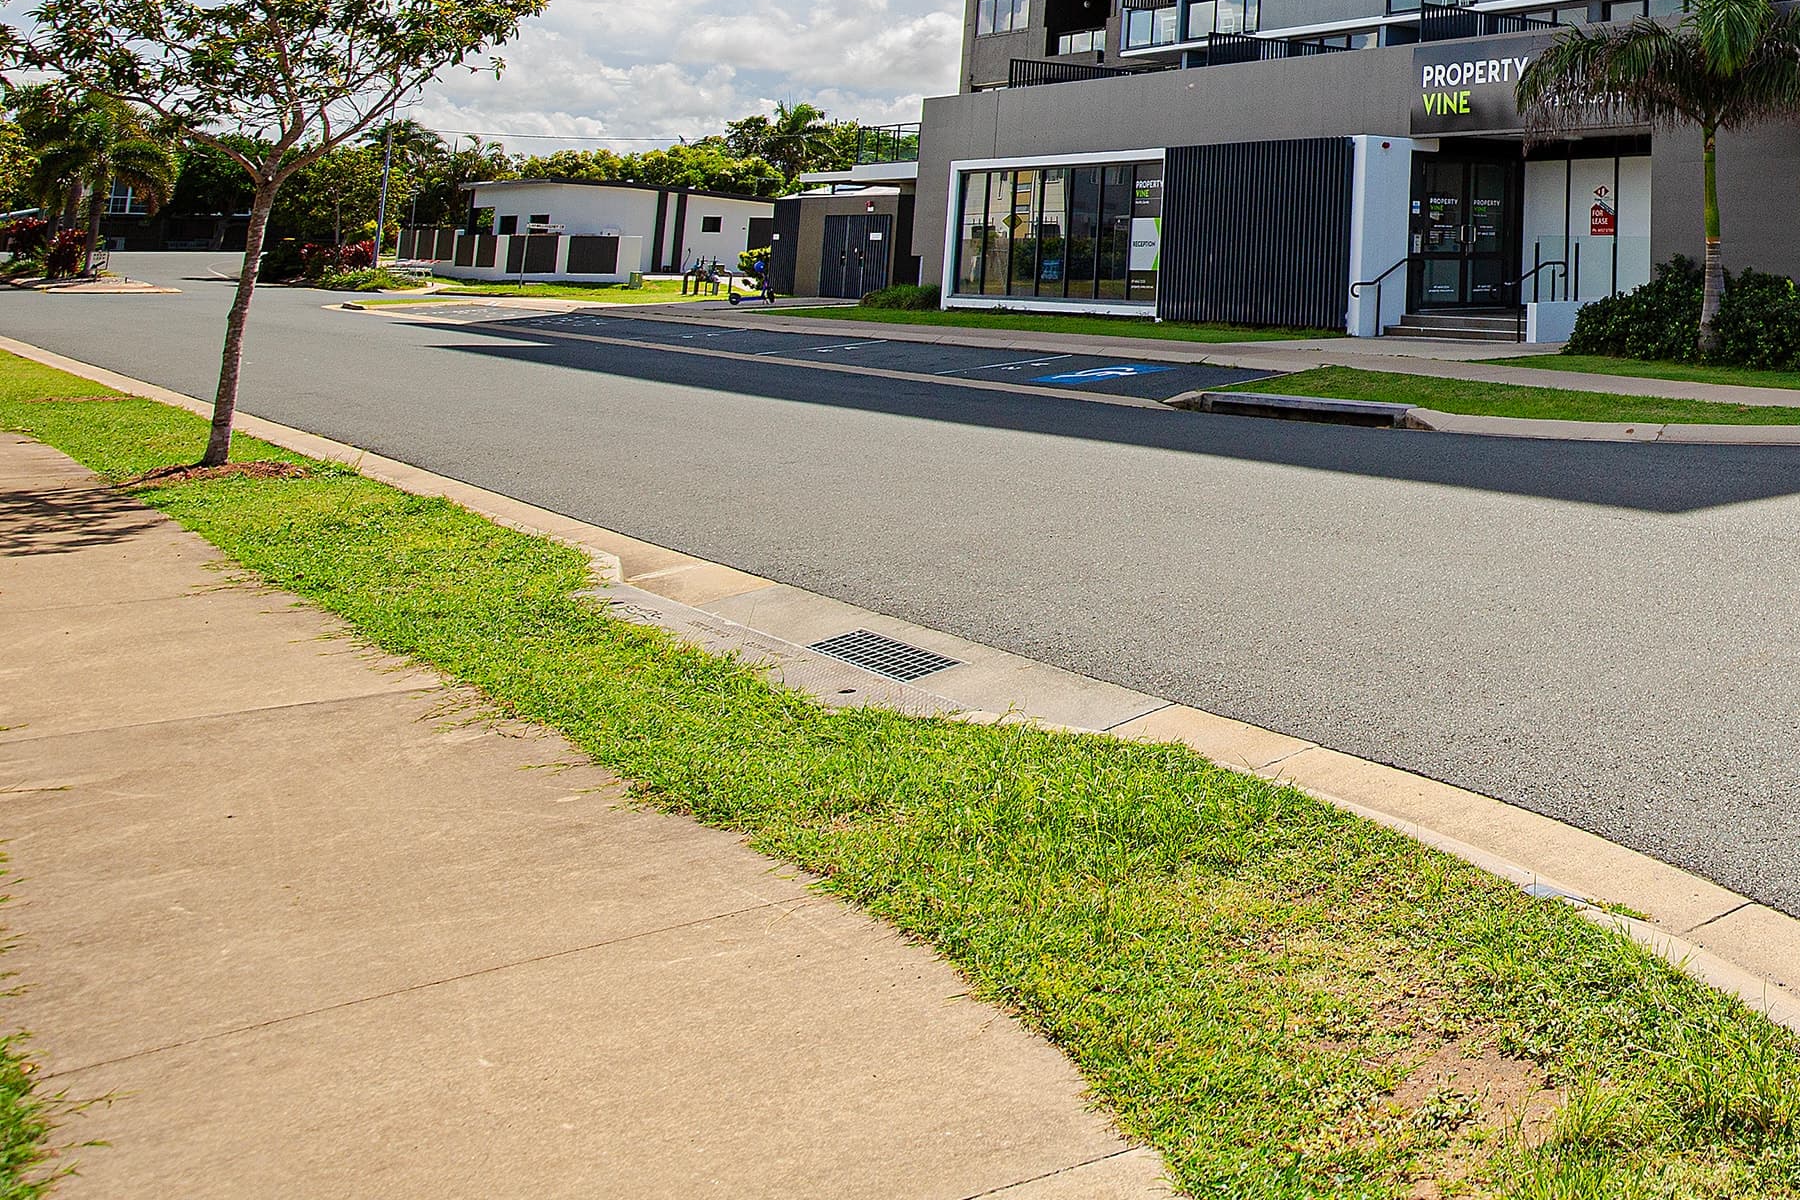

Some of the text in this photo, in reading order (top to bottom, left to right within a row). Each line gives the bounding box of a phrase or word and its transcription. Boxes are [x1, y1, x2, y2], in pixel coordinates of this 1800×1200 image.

[1422, 57, 1528, 88] PROPERTY
[1423, 90, 1471, 116] VINE
[1136, 180, 1163, 189] PROPERTY
[1429, 197, 1458, 205] PROPERTY
[1592, 209, 1604, 217] FOR
[1592, 217, 1608, 225] LEASE
